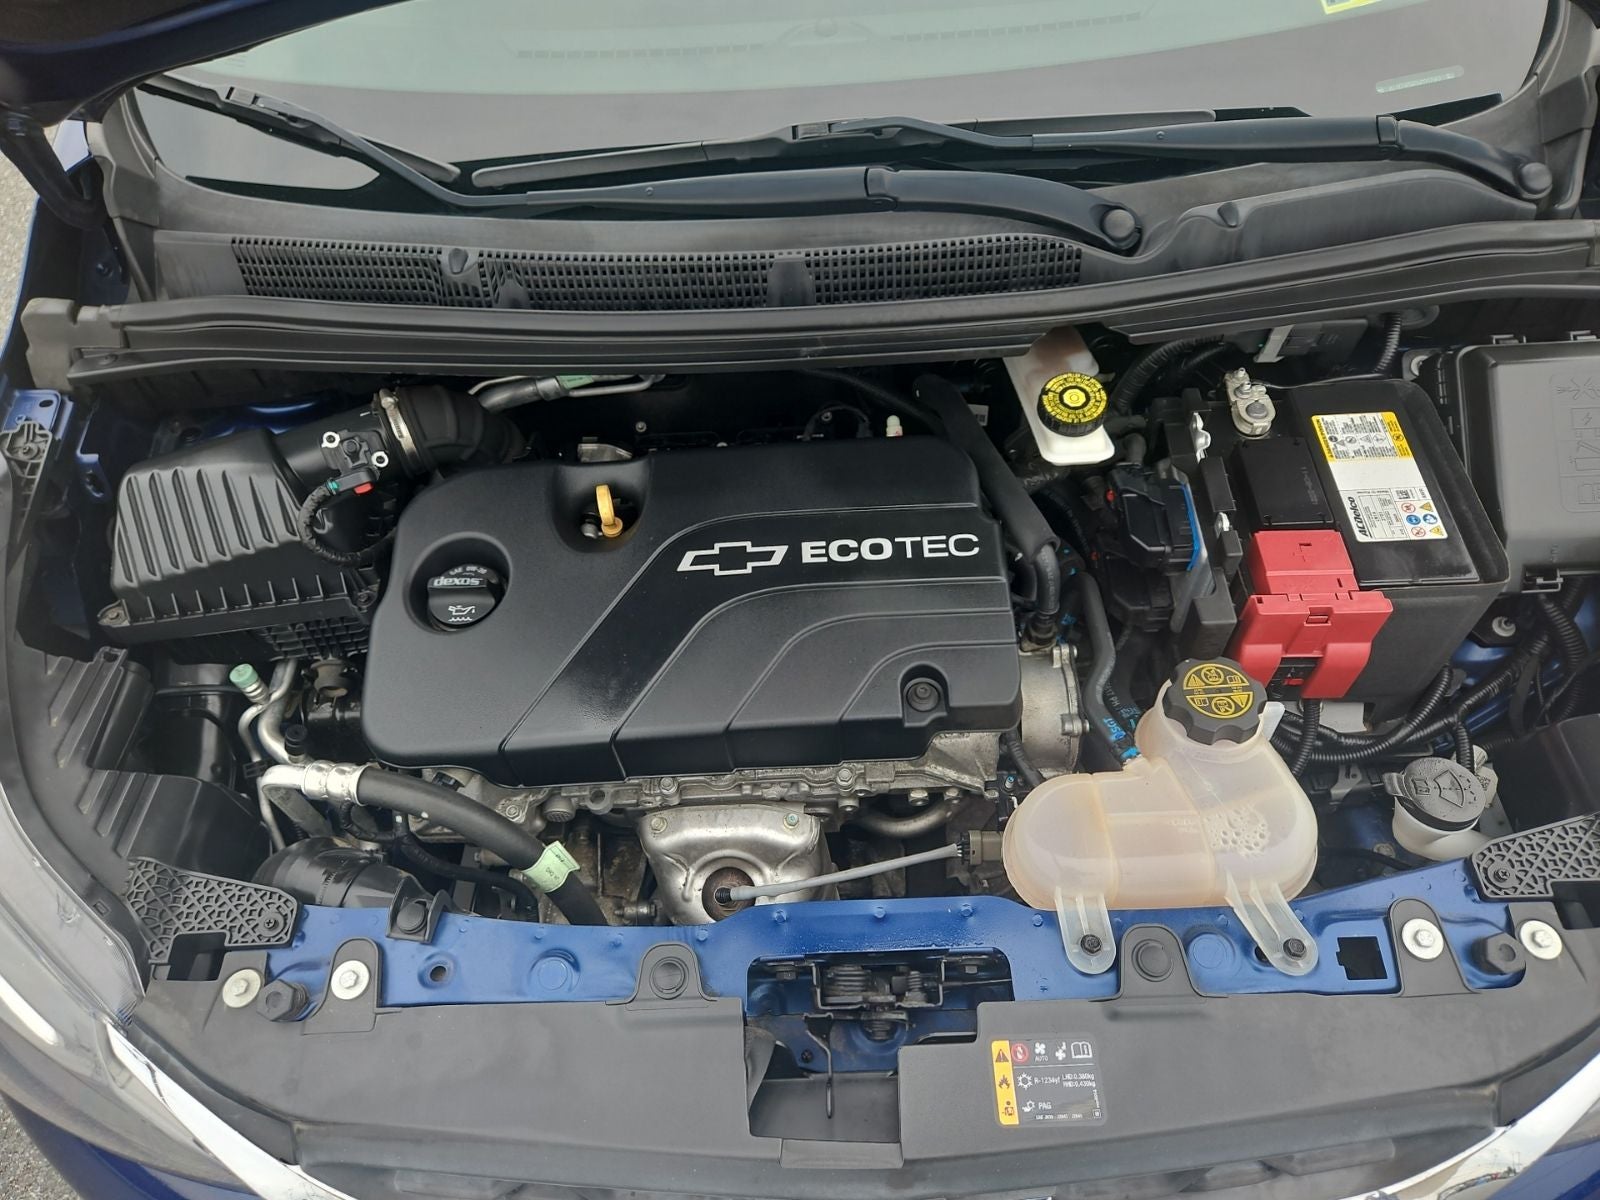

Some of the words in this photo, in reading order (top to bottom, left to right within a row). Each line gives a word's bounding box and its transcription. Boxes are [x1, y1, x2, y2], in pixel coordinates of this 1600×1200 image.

[1348, 497, 1368, 537] ACDelco
[801, 533, 980, 564] ECOTEC
[434, 576, 481, 587] dexos
[1038, 1101, 1052, 1110] PAG
